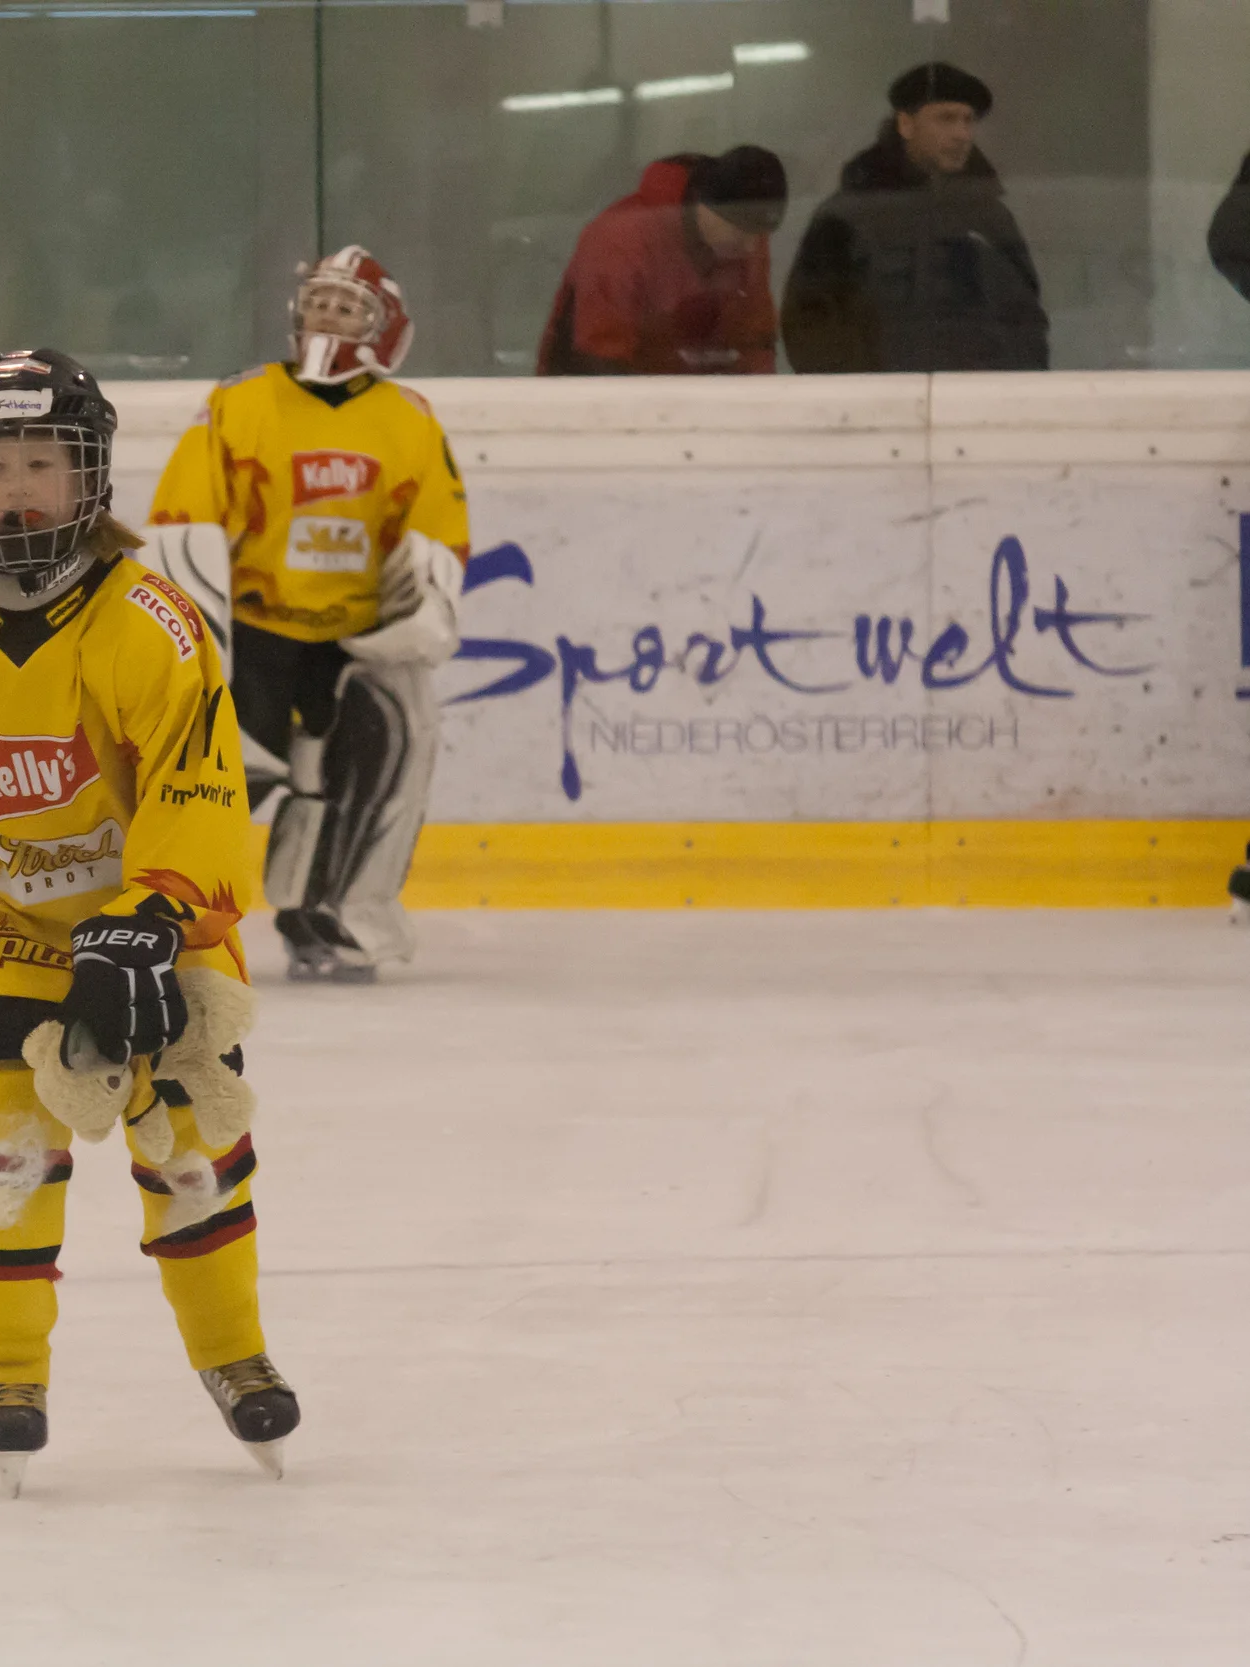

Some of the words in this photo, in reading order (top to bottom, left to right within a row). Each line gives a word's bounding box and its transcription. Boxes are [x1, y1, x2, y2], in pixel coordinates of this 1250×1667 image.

[131, 588, 192, 657] RICOH
[855, 535, 1153, 698] welt
[23, 866, 96, 893] BROT
